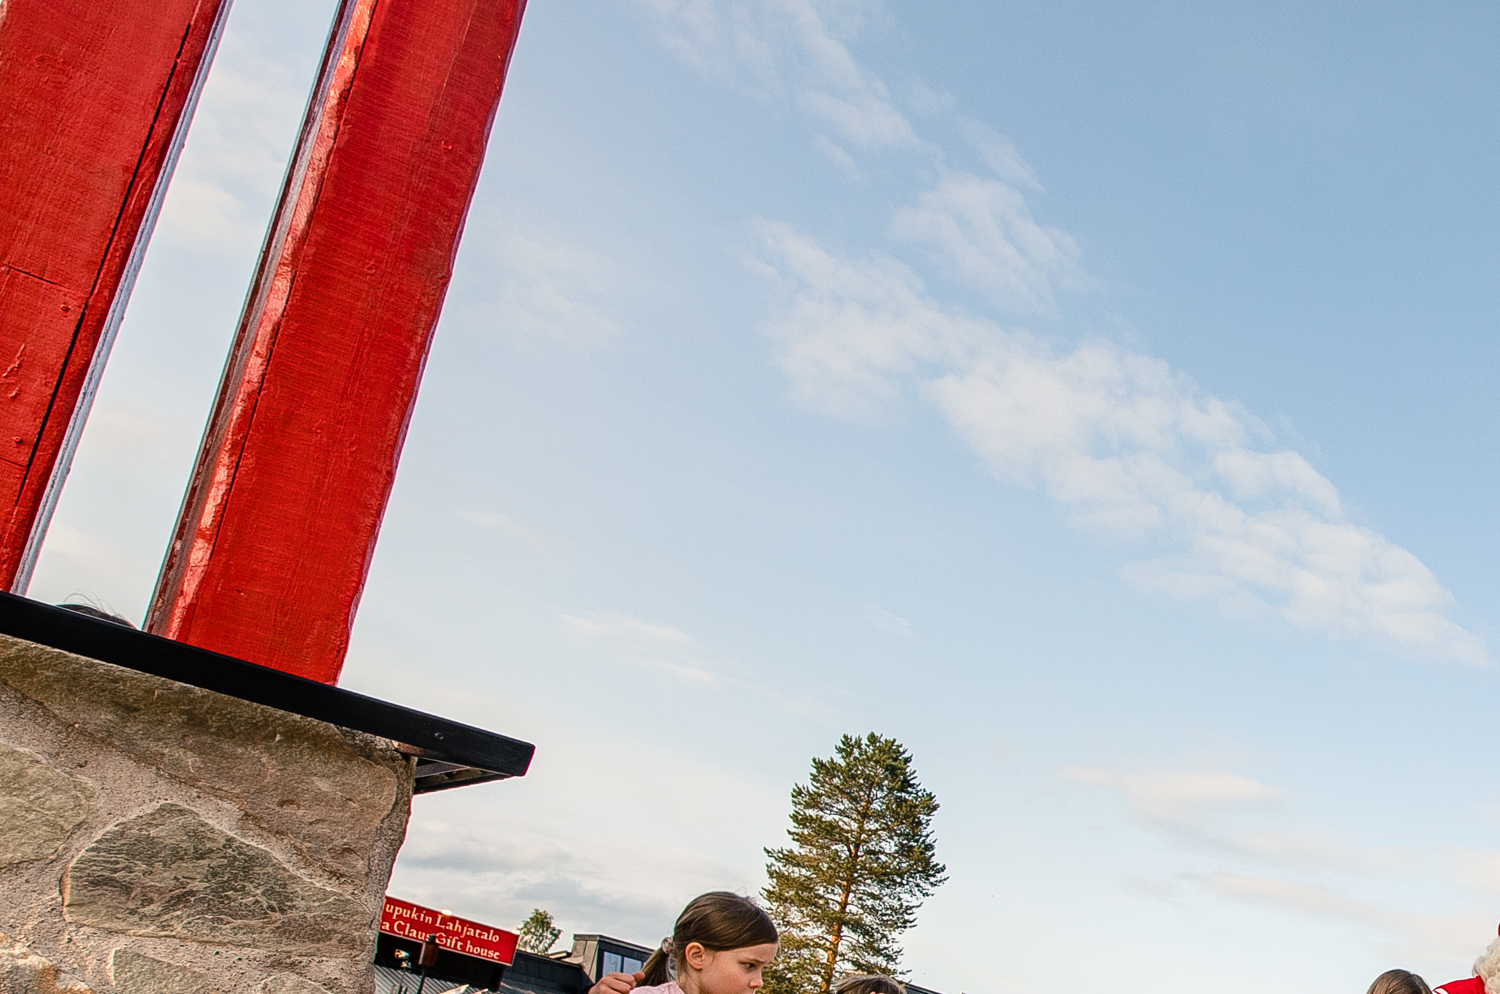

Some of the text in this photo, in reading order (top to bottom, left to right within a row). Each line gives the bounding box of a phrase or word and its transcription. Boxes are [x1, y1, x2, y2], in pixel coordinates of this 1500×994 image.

[393, 920, 430, 941] Claus
[435, 931, 464, 951] Gift
[465, 940, 500, 960] house
[435, 913, 500, 943] Lahjatalo
